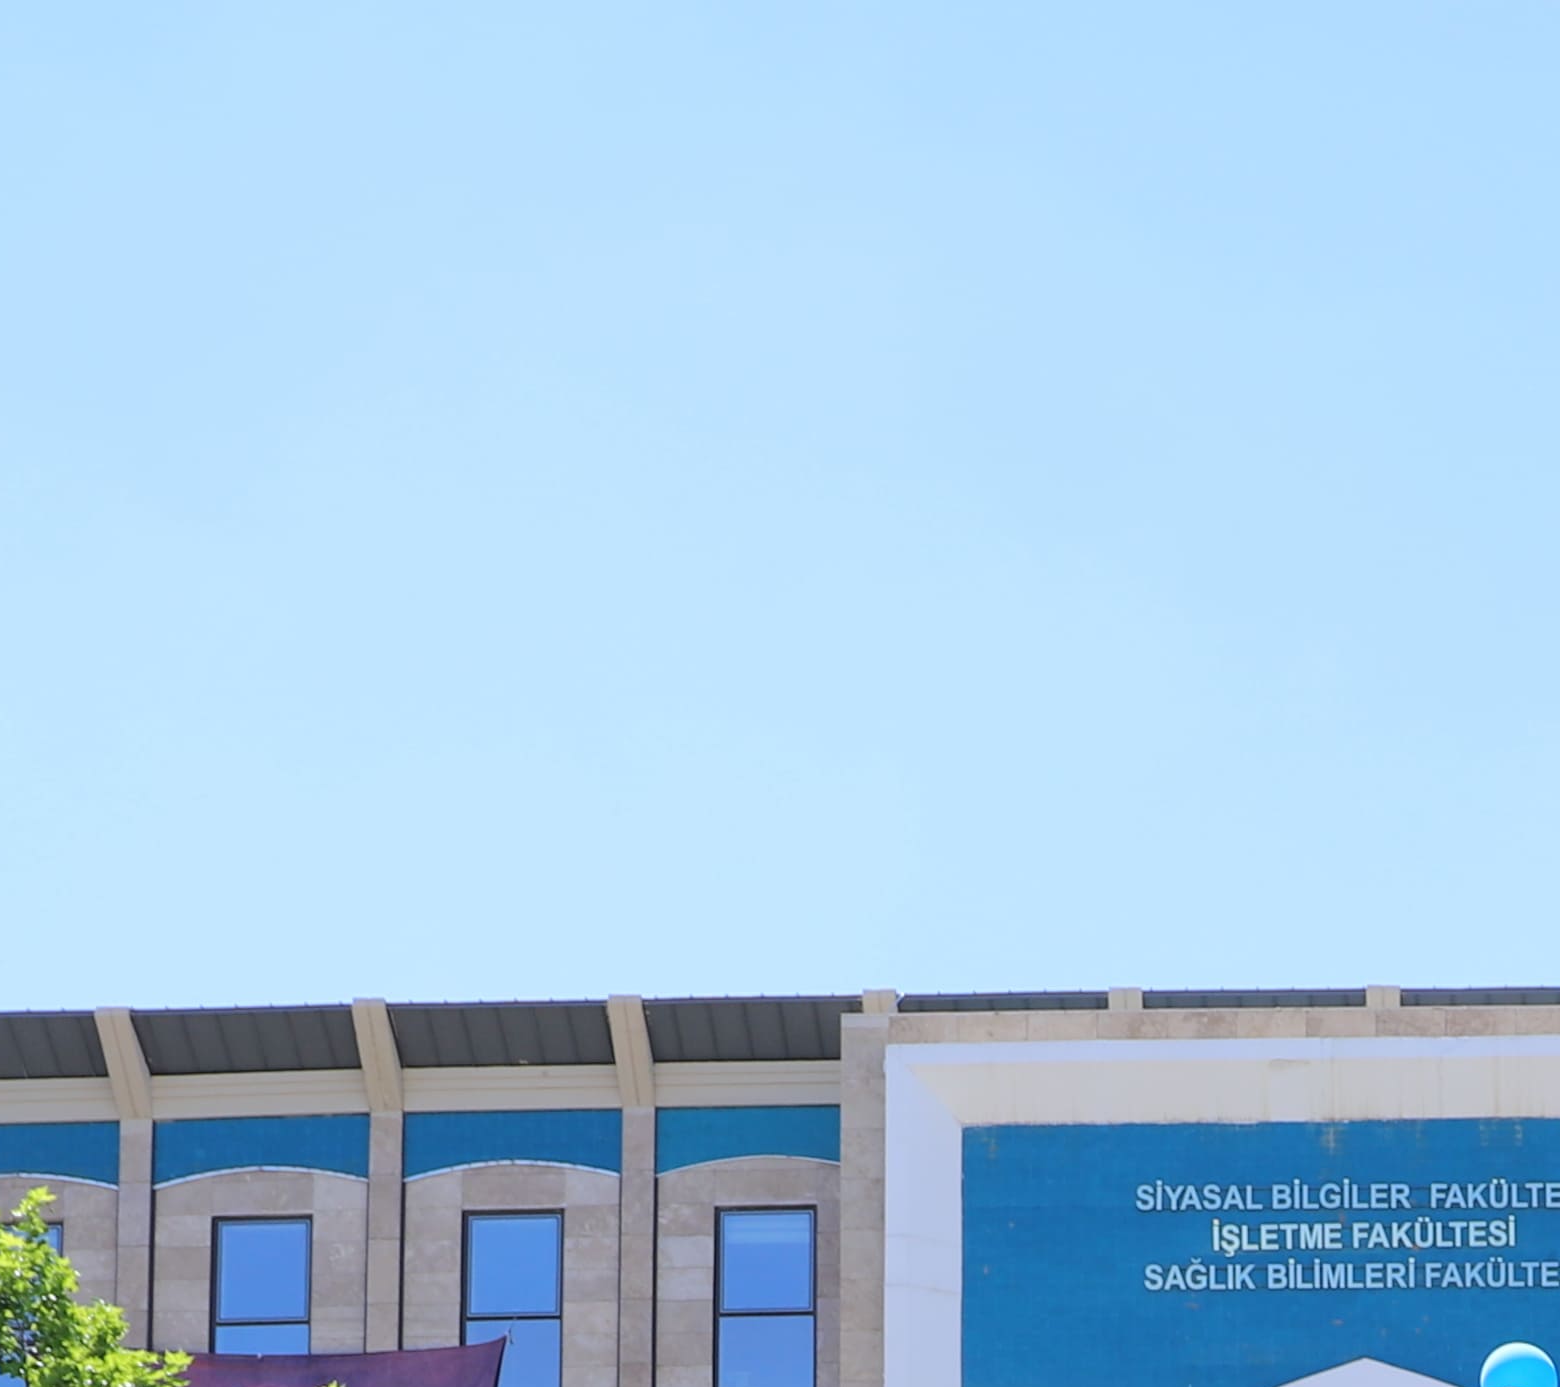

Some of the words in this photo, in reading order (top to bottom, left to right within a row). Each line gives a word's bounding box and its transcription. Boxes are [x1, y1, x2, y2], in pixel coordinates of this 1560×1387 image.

[1136, 1179, 1263, 1212] SİYASAL
[1271, 1178, 1411, 1211] BİLGİLER
[1212, 1218, 1343, 1258] İŞLETME
[1352, 1214, 1517, 1250] FAKÜLTESİ
[1143, 1257, 1257, 1292] SAĞLIK
[1266, 1257, 1416, 1291] BİLİMLERİ
